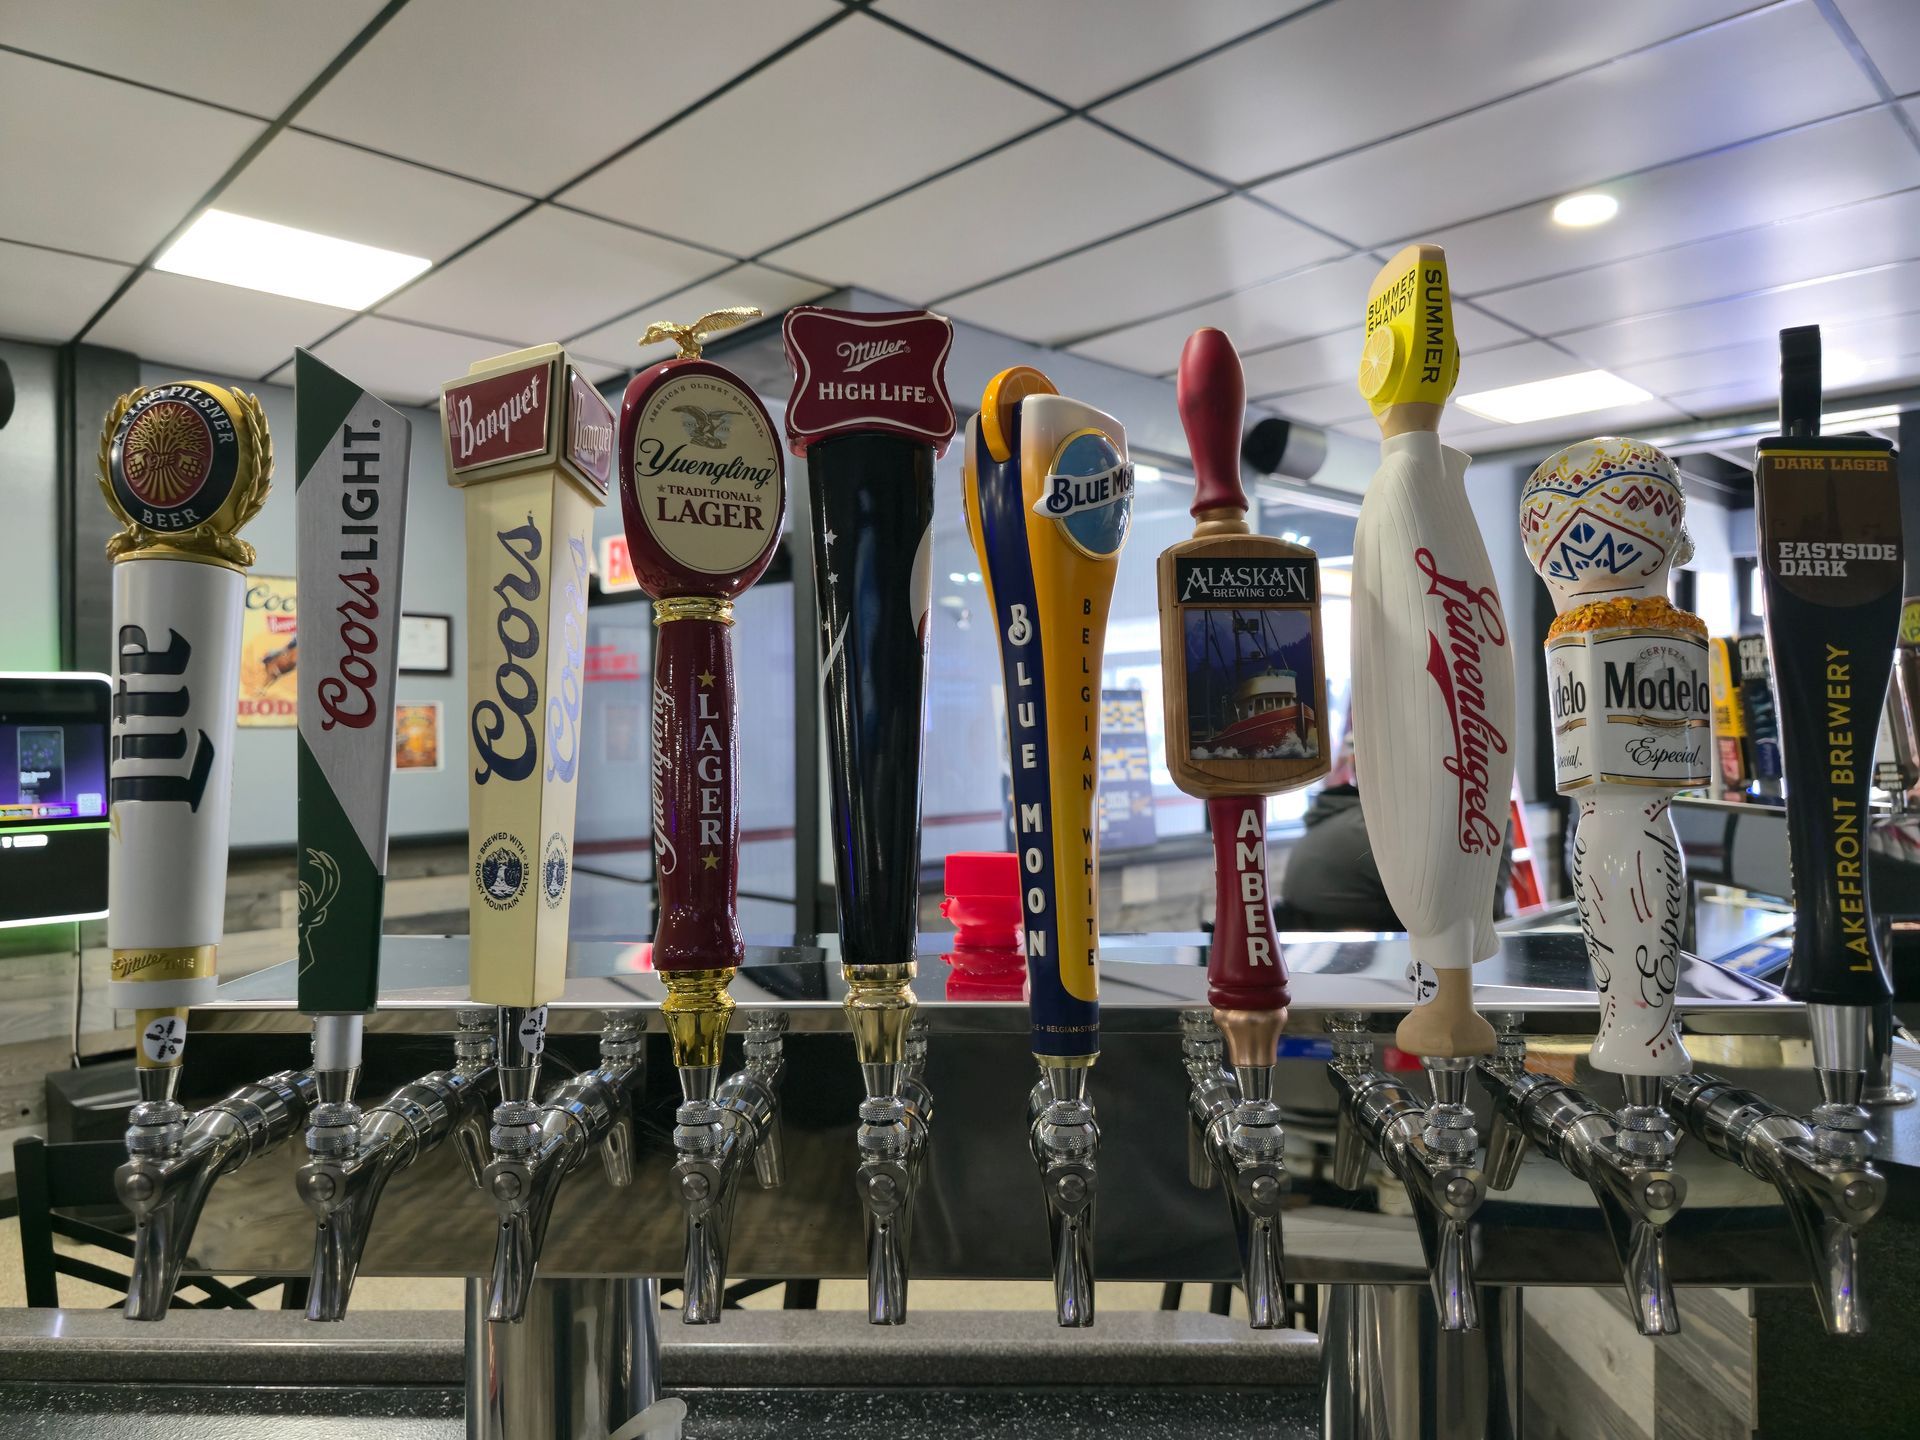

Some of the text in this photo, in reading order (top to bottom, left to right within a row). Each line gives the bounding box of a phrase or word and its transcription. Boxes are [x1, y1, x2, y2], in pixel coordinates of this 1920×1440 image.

[1368, 269, 1416, 321] SUMMER
[1368, 288, 1414, 338] SHANDY
[1421, 269, 1443, 384] SUMMER
[837, 340, 906, 372] Miller
[690, 383, 729, 396] OLDEST
[818, 382, 927, 403] HIGH LIFE
[113, 386, 234, 447] A FINE PILSNER
[458, 374, 540, 459] Banquet
[635, 438, 778, 490] Yuengling
[1773, 457, 1889, 472] DARK LAGER
[142, 508, 200, 528] BEER
[341, 423, 381, 561] LIGHT
[656, 497, 765, 531] LAGER
[667, 484, 755, 503] TRADITIONAL
[1046, 477, 1110, 513] BLUE
[1779, 541, 1897, 561] EASTSIDE
[1779, 559, 1848, 577] DARK
[1181, 566, 1309, 602] ALASKAN
[1213, 587, 1287, 598] BREWING CO.
[318, 567, 380, 730] Coors
[470, 513, 542, 786] Coors
[546, 531, 588, 784] Coors
[1604, 662, 1710, 714] Modelo
[112, 626, 214, 813] Lite
[697, 693, 723, 847] LAGER
[1625, 737, 1701, 771] Especial
[1007, 604, 1047, 957] BLUE MOON
[1081, 599, 1096, 966] BELGIAN WHITE
[1826, 643, 1873, 973] LAKEFRONT BREWERY
[480, 832, 526, 854] BREWED WITH
[475, 862, 486, 895] ROCKY
[484, 896, 520, 911] MOUNTAIN
[518, 862, 530, 896] WATER
[1236, 809, 1273, 967] AMBER
[1635, 831, 1681, 1008] Especial
